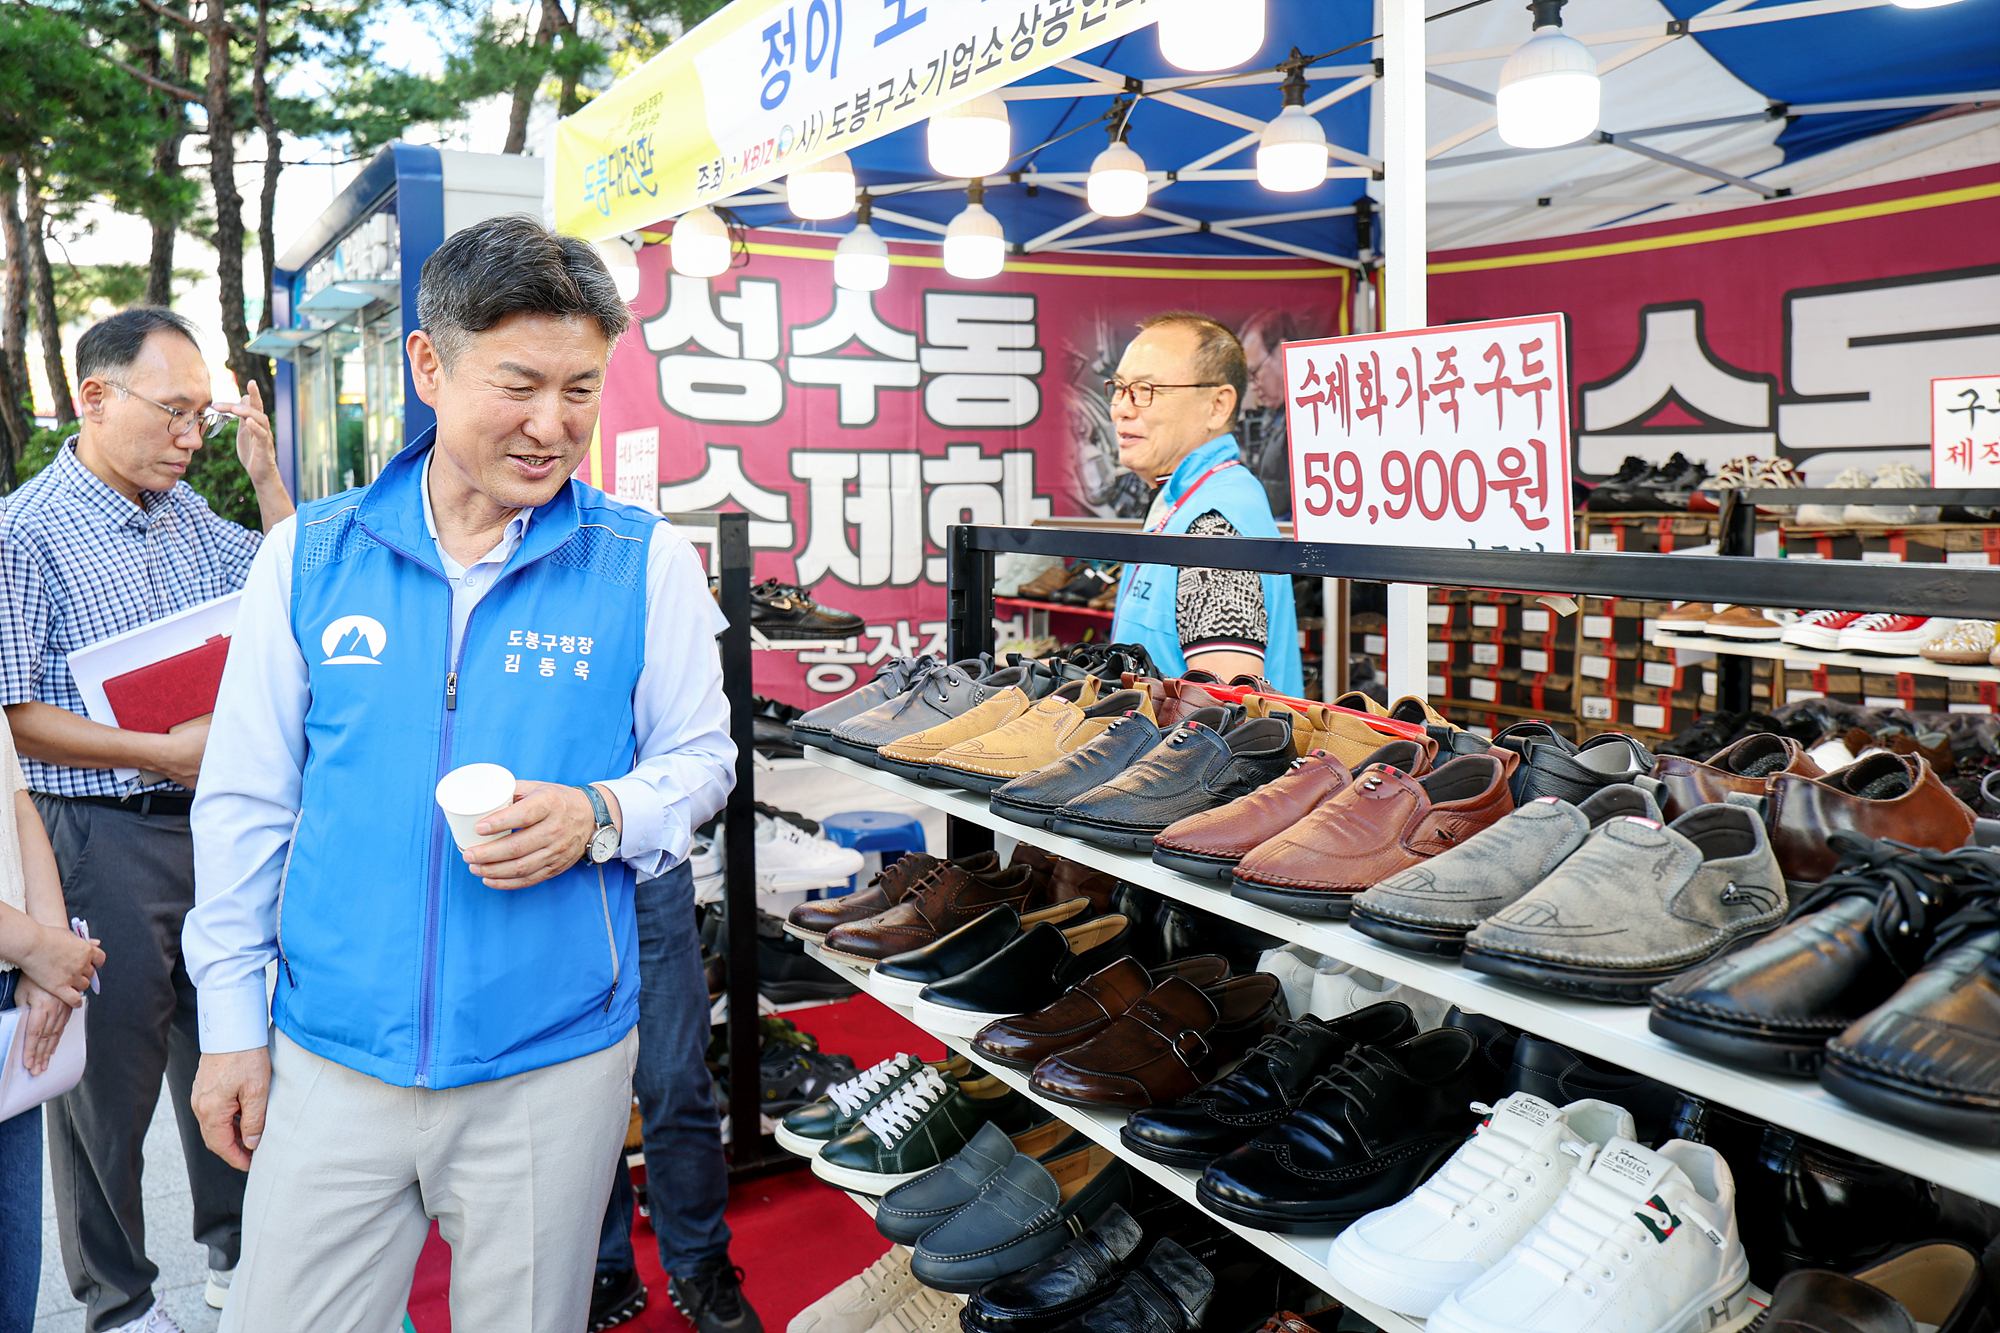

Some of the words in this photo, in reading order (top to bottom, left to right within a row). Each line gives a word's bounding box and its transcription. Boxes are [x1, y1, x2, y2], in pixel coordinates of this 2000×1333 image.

[760, 0, 842, 110] 정이
[697, 157, 725, 197] 주최
[741, 138, 774, 175] KBIZ
[642, 270, 1043, 429] 성수동
[1296, 350, 1388, 437] 수제화
[1396, 346, 1465, 435] 가죽
[1474, 337, 1552, 431] 구두
[1946, 388, 2000, 431] 구
[1304, 438, 1550, 531] 59,900원
[657, 443, 1052, 590] 수제화
[506, 630, 594, 655] 도봉구청장
[1101, 834, 1127, 846] AIR
[1511, 1099, 1552, 1119] FASHION
[1607, 1151, 1653, 1177] FASHION
